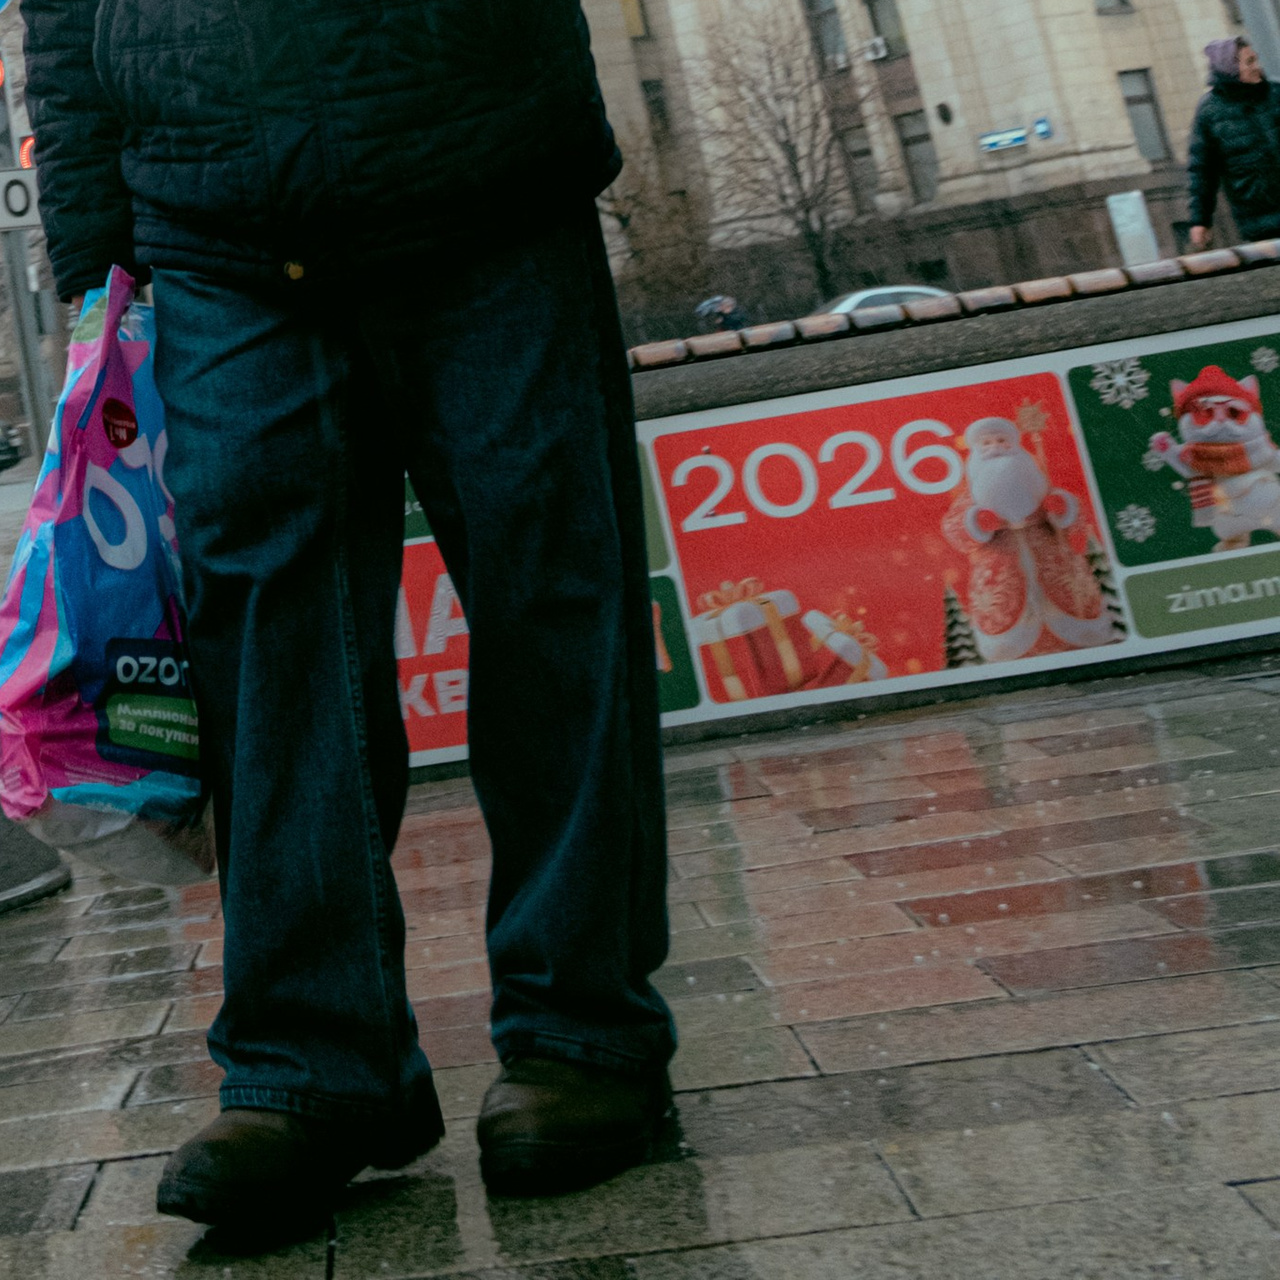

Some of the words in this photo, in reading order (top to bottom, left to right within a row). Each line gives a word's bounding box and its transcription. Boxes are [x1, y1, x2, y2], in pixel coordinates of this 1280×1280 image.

[670, 417, 965, 534] 2026
[118, 718, 136, 732] за
[139, 723, 200, 746] покупки
